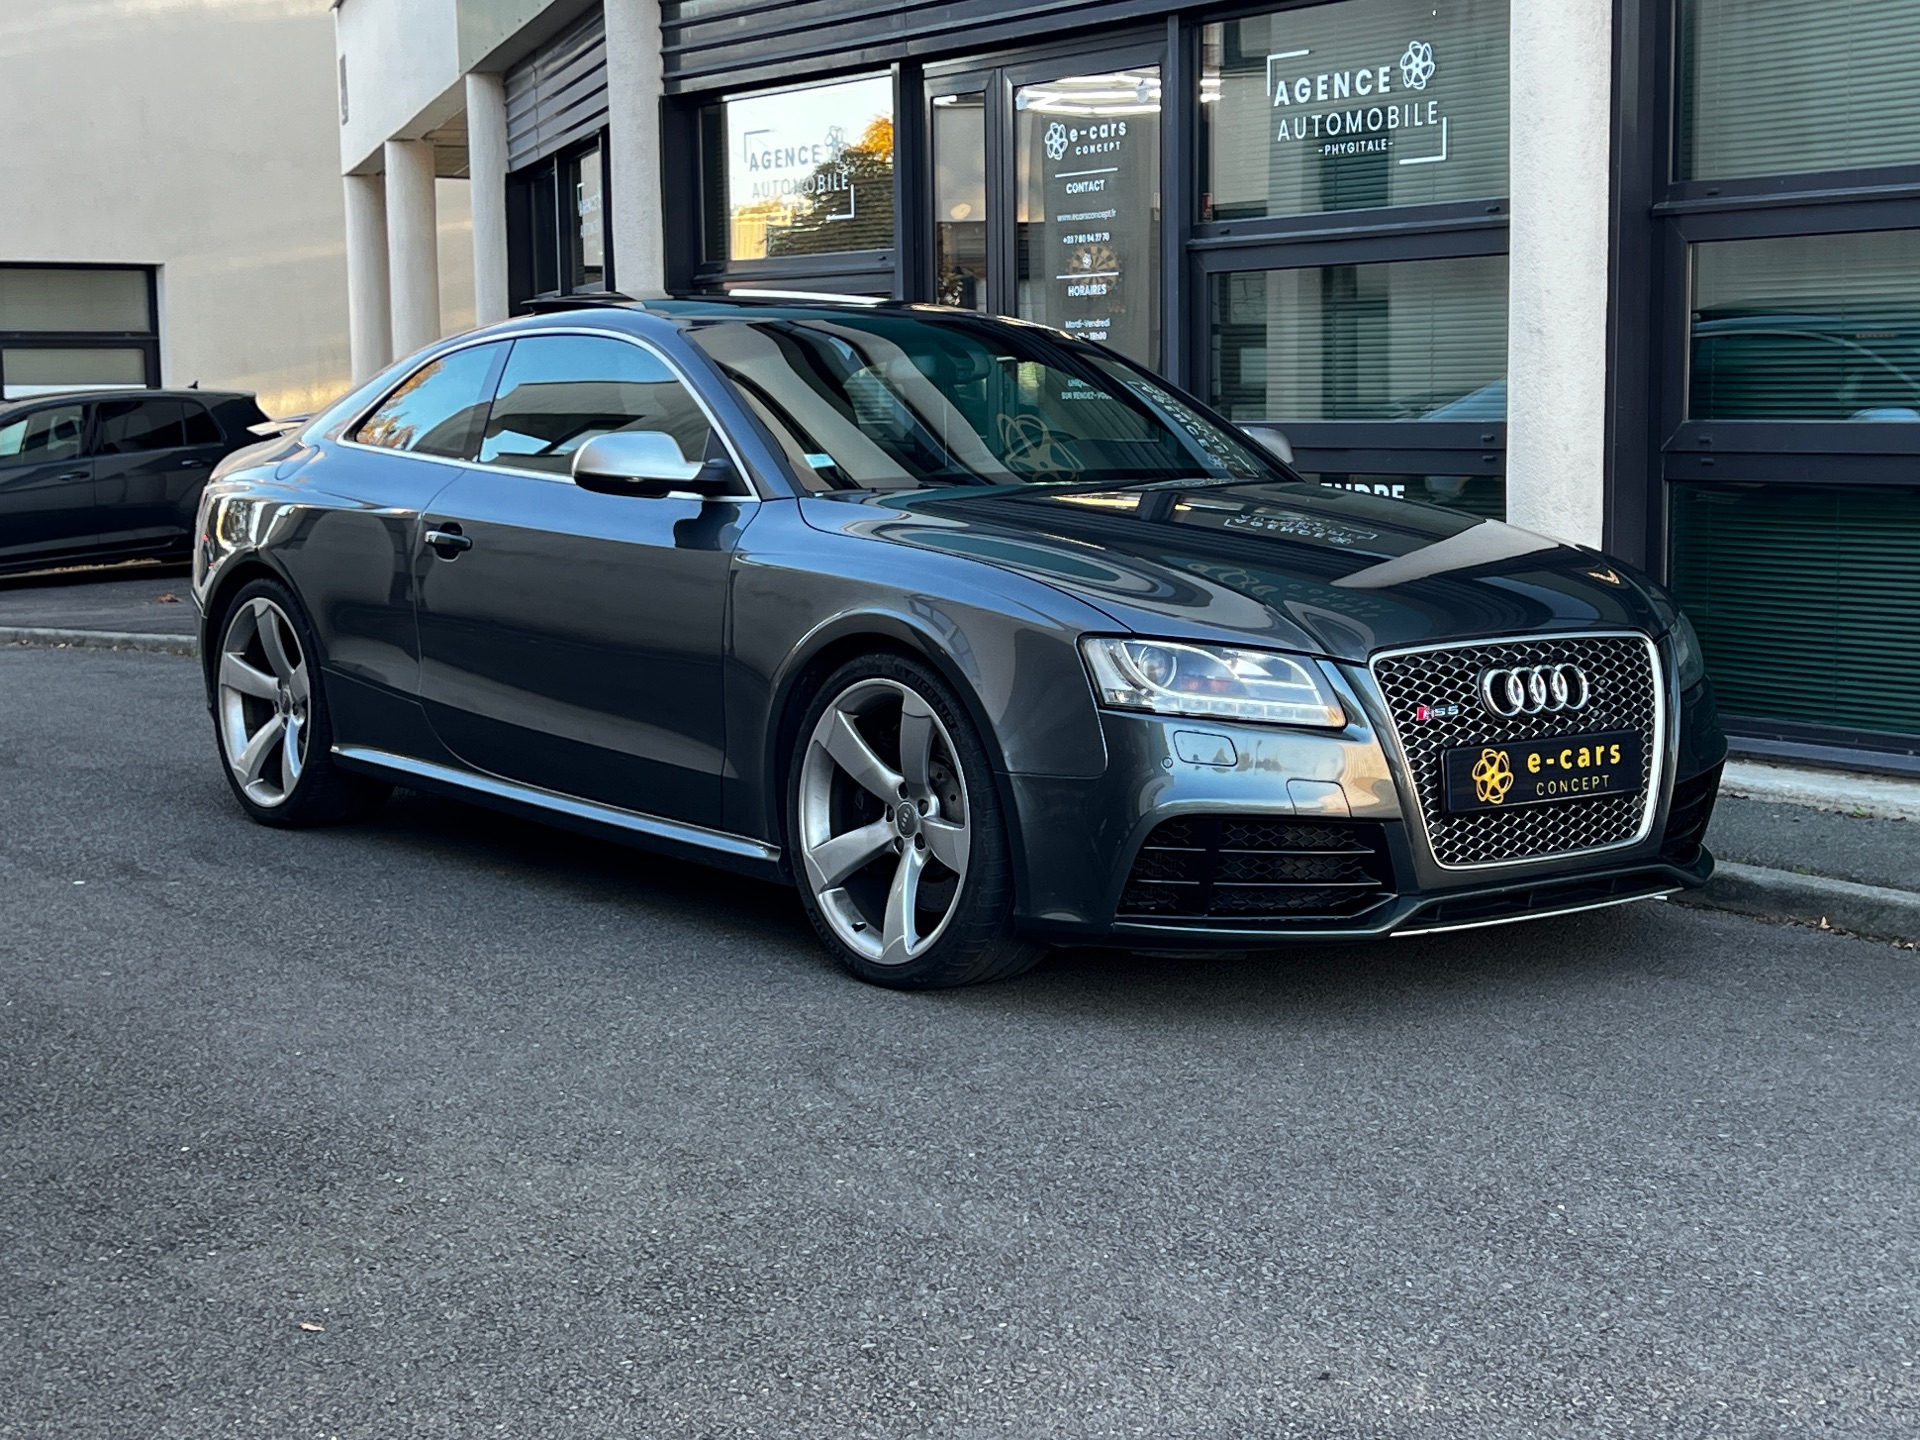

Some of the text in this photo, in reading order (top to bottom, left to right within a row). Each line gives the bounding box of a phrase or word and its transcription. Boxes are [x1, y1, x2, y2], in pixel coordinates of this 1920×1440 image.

[1273, 65, 1391, 107] AGENCE
[1069, 120, 1127, 143] e-cars
[1277, 100, 1438, 142] AUTOMOBILE
[749, 143, 821, 172] AGENCE
[1075, 141, 1121, 156] CONCEPT
[752, 172, 849, 199] AUTOMOBILE
[1066, 179, 1105, 194] CONTACT
[1068, 284, 1107, 297] HORAIRES
[1527, 744, 1622, 774] e-cars
[1536, 774, 1611, 796] CONCEPT
